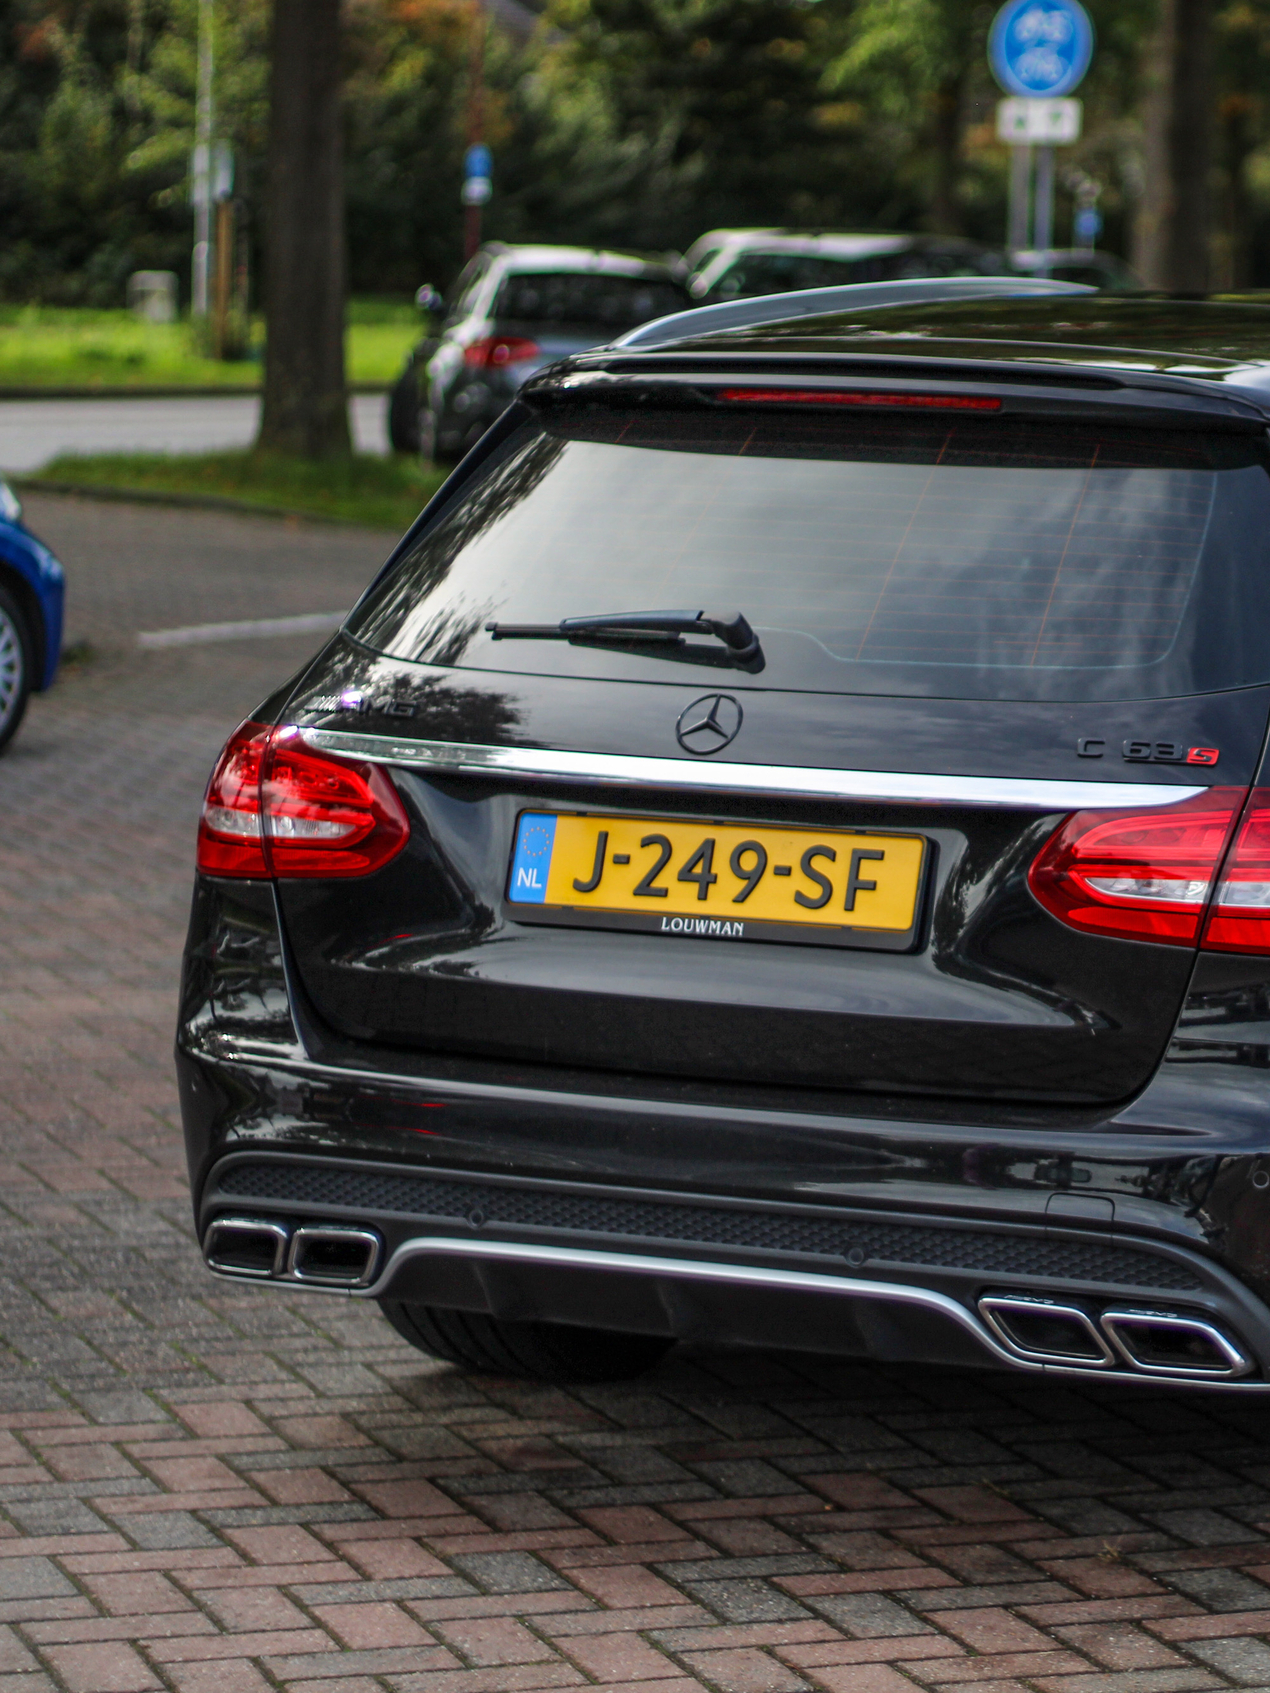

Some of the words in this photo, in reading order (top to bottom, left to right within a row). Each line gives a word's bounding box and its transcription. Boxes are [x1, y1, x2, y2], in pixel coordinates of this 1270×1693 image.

[1077, 737, 1105, 758] C
[517, 867, 542, 889] NL
[571, 831, 886, 912] J-249-SF
[661, 916, 744, 936] LOUWMAN
